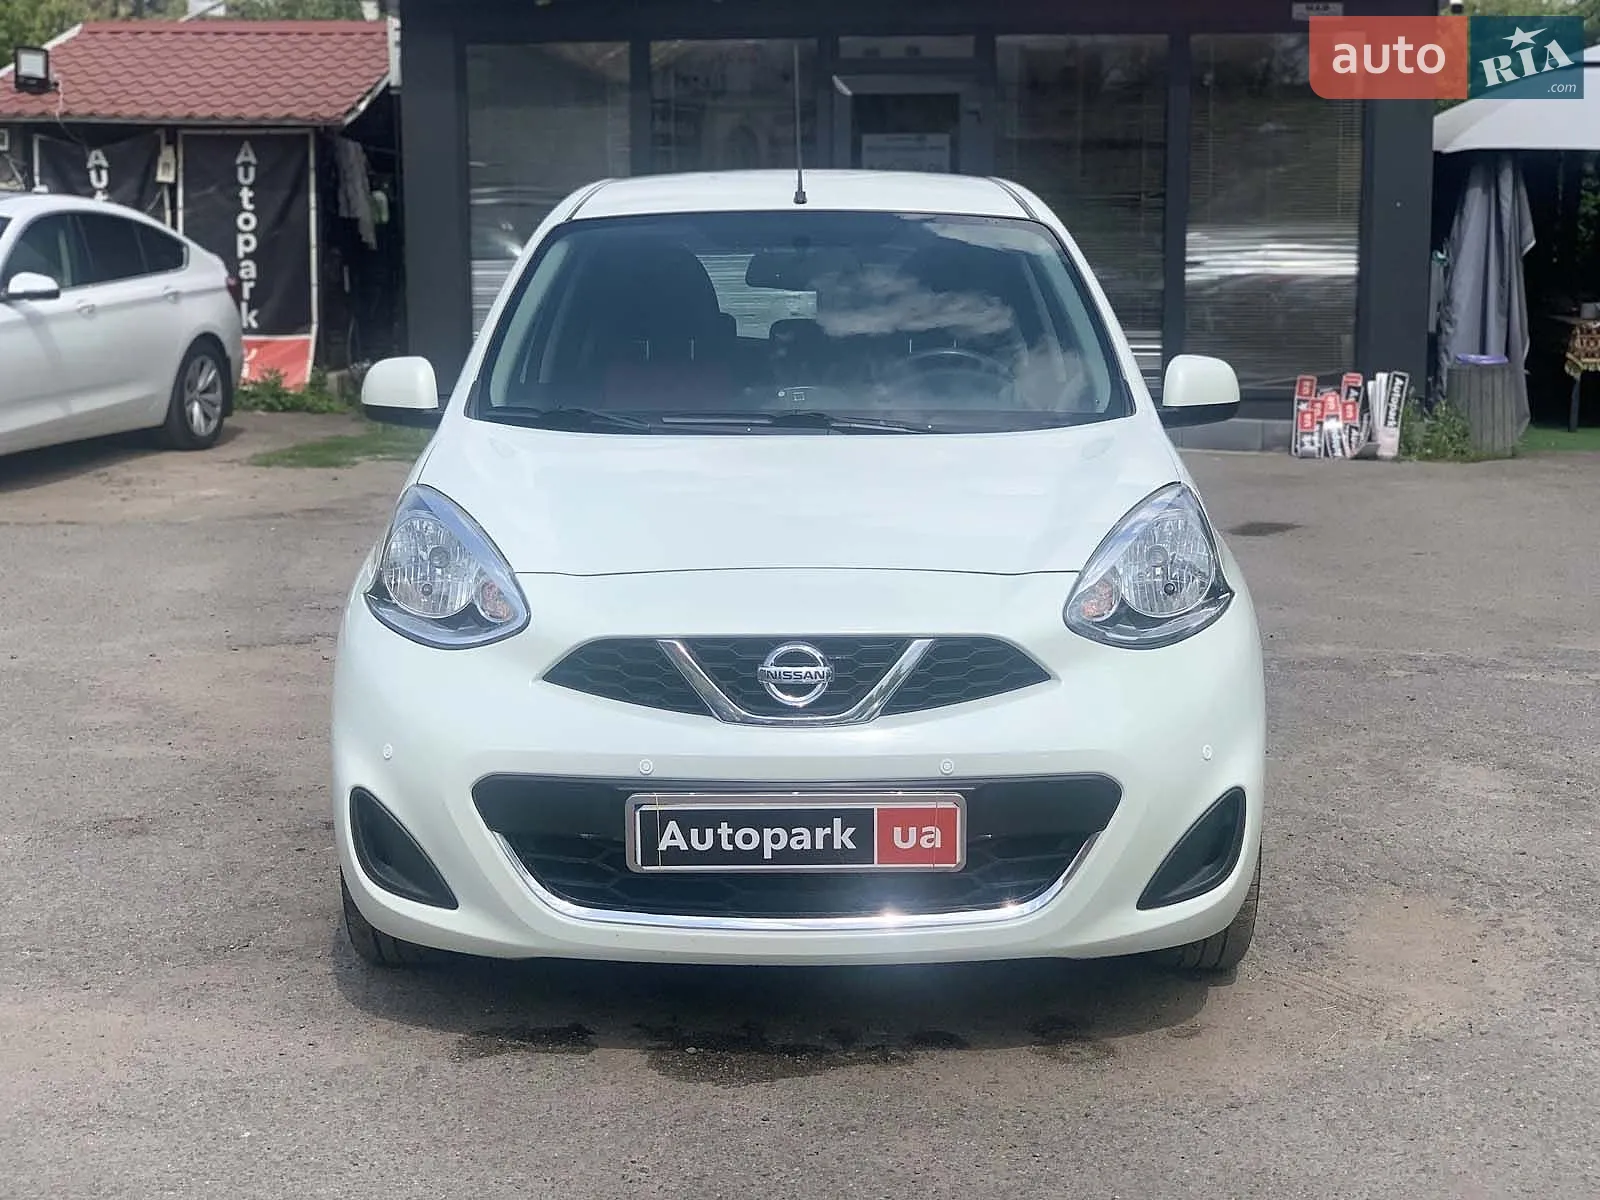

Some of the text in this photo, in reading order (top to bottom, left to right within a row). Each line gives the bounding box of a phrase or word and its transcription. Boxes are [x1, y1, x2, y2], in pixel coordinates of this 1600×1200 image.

[235, 141, 259, 329] Autopark
[766, 670, 825, 680] NISSAN
[657, 817, 942, 860] Autopark ua
